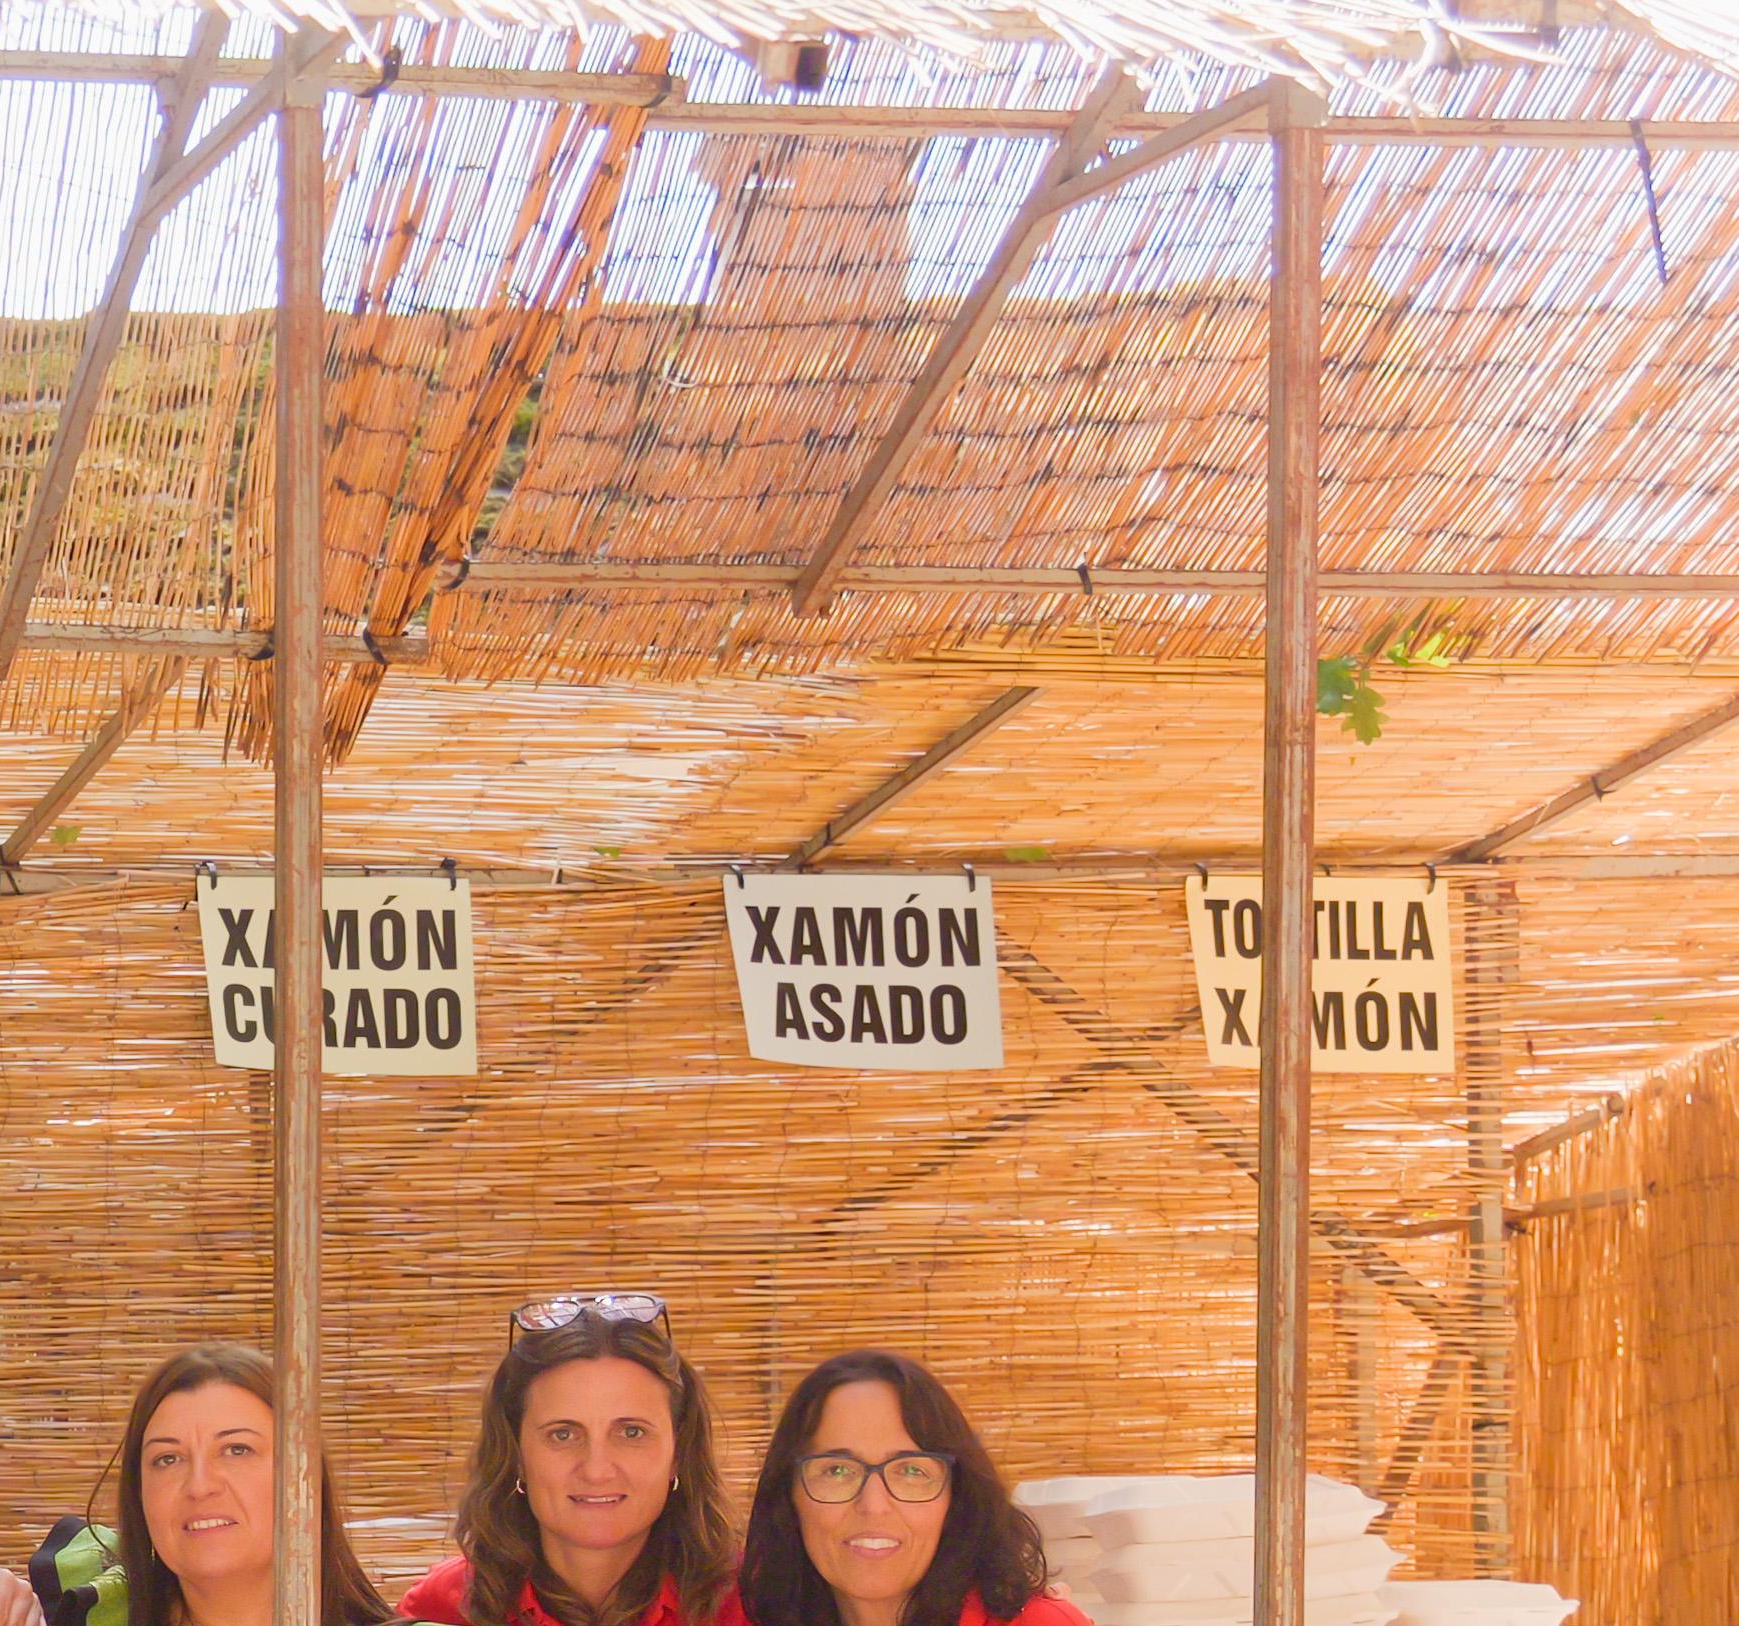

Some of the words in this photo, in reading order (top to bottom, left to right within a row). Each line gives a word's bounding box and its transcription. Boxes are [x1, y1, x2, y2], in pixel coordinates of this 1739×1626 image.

[745, 893, 981, 968] XAMÓN
[1204, 898, 1435, 960] TOILLA
[775, 982, 968, 1046] ASADO
[1214, 978, 1438, 1052] XMÓN
